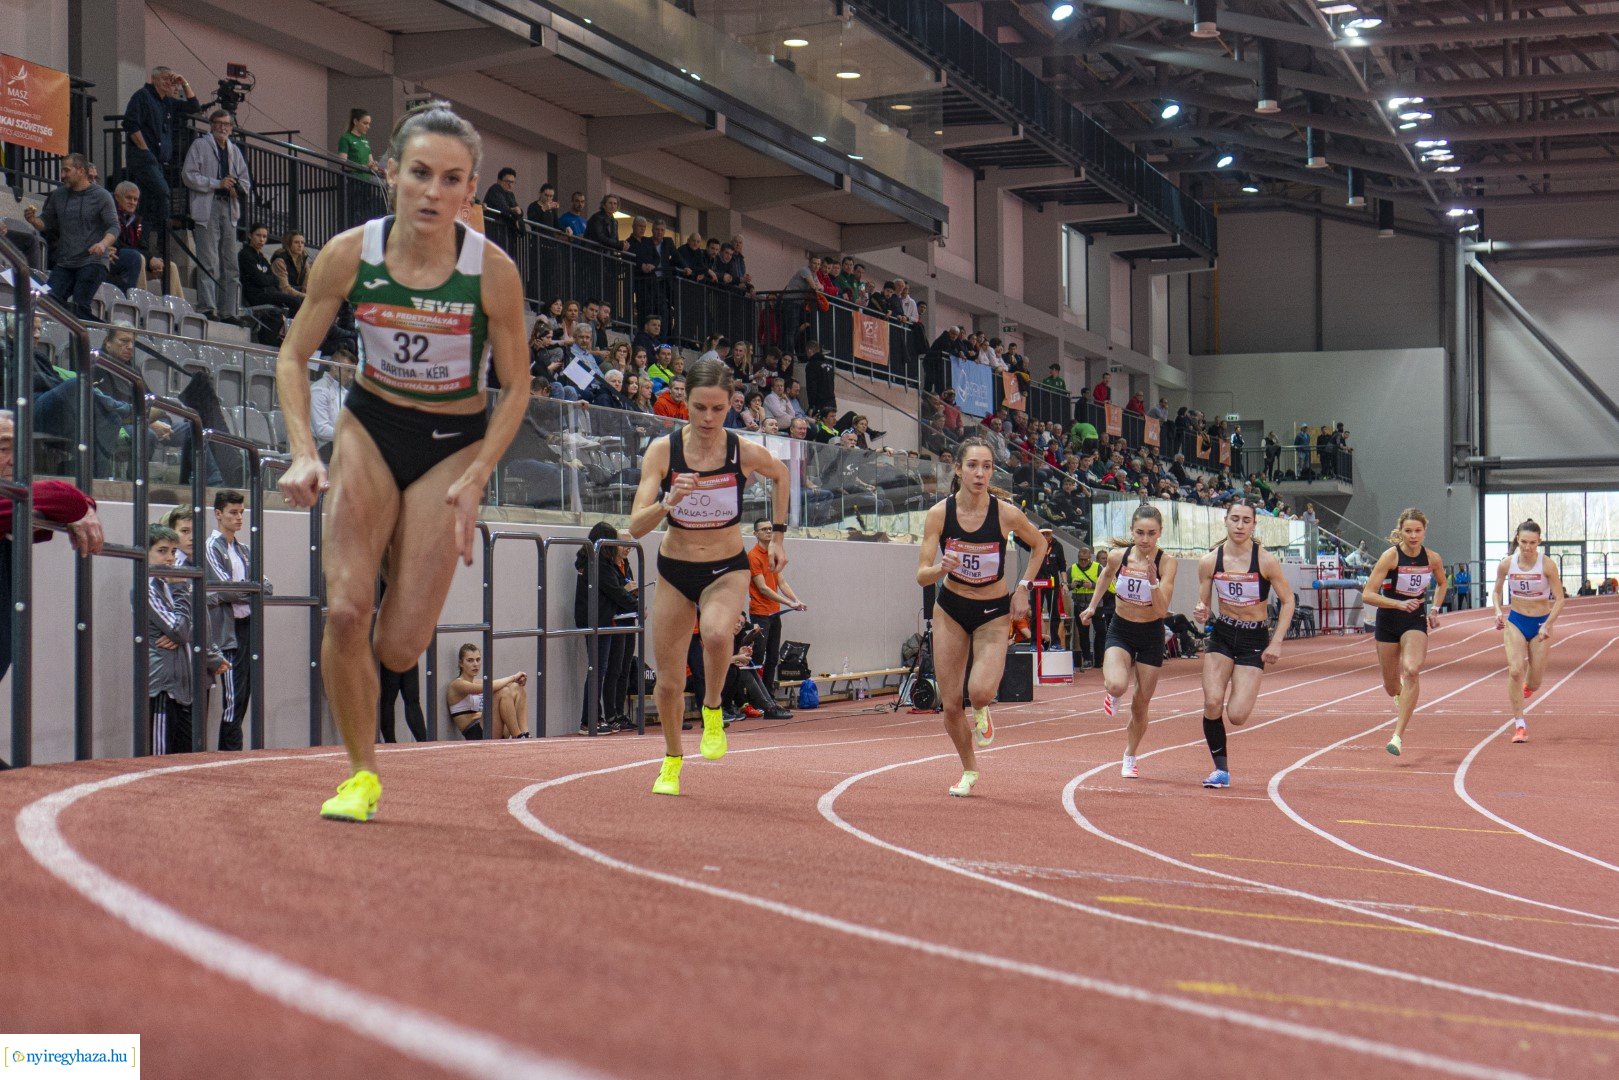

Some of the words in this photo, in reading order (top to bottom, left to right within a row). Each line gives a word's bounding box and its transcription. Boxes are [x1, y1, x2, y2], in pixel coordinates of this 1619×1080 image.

[8, 88, 28, 100] MASZ
[393, 332, 429, 363] 32
[380, 359, 417, 378] BARTHA
[426, 363, 449, 379] KÉRI
[689, 492, 711, 507] 50
[963, 554, 980, 571] 55
[1127, 579, 1142, 593] 87
[1410, 575, 1422, 587] 59
[1520, 581, 1530, 591] 51
[1229, 582, 1243, 596] 66
[1234, 620, 1258, 629] PRO
